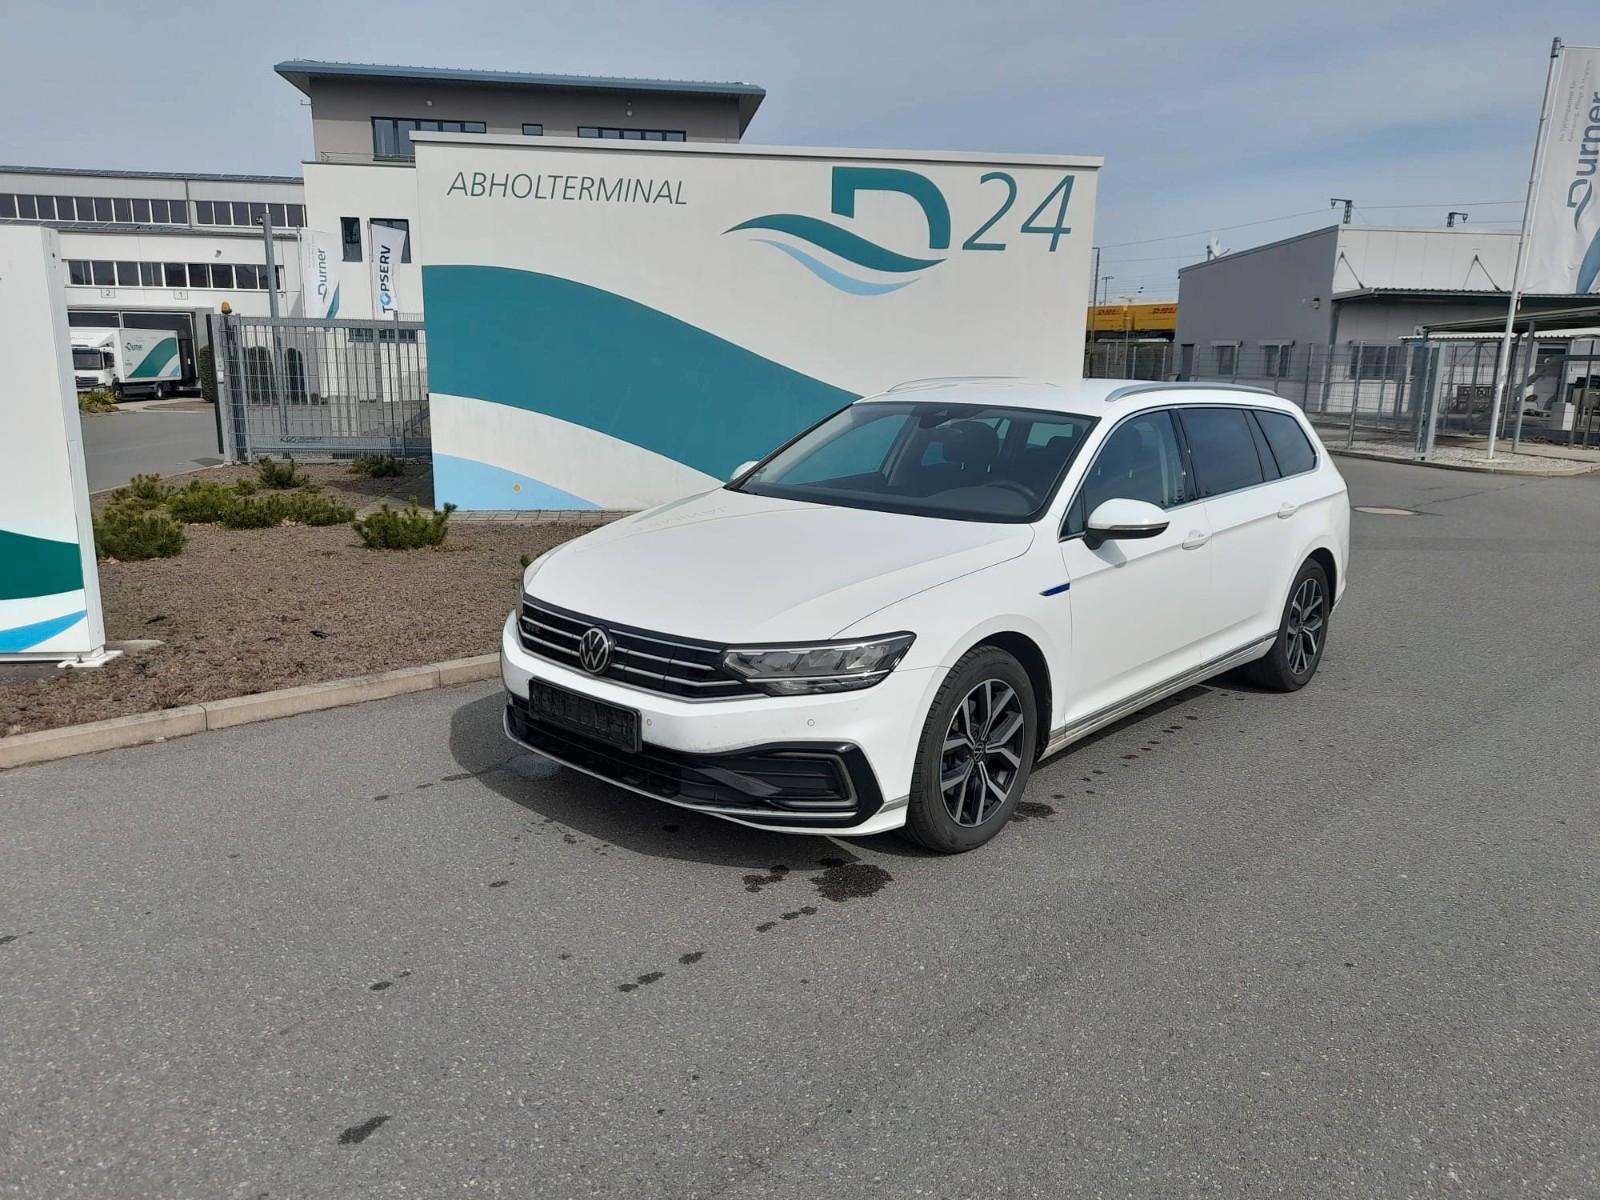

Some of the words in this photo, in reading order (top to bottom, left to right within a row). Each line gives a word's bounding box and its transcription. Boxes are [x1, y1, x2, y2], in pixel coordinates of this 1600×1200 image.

[446, 171, 687, 205] ABHOLTERMINAL
[962, 171, 1075, 252] 24
[380, 244, 394, 314] TOPSERV
